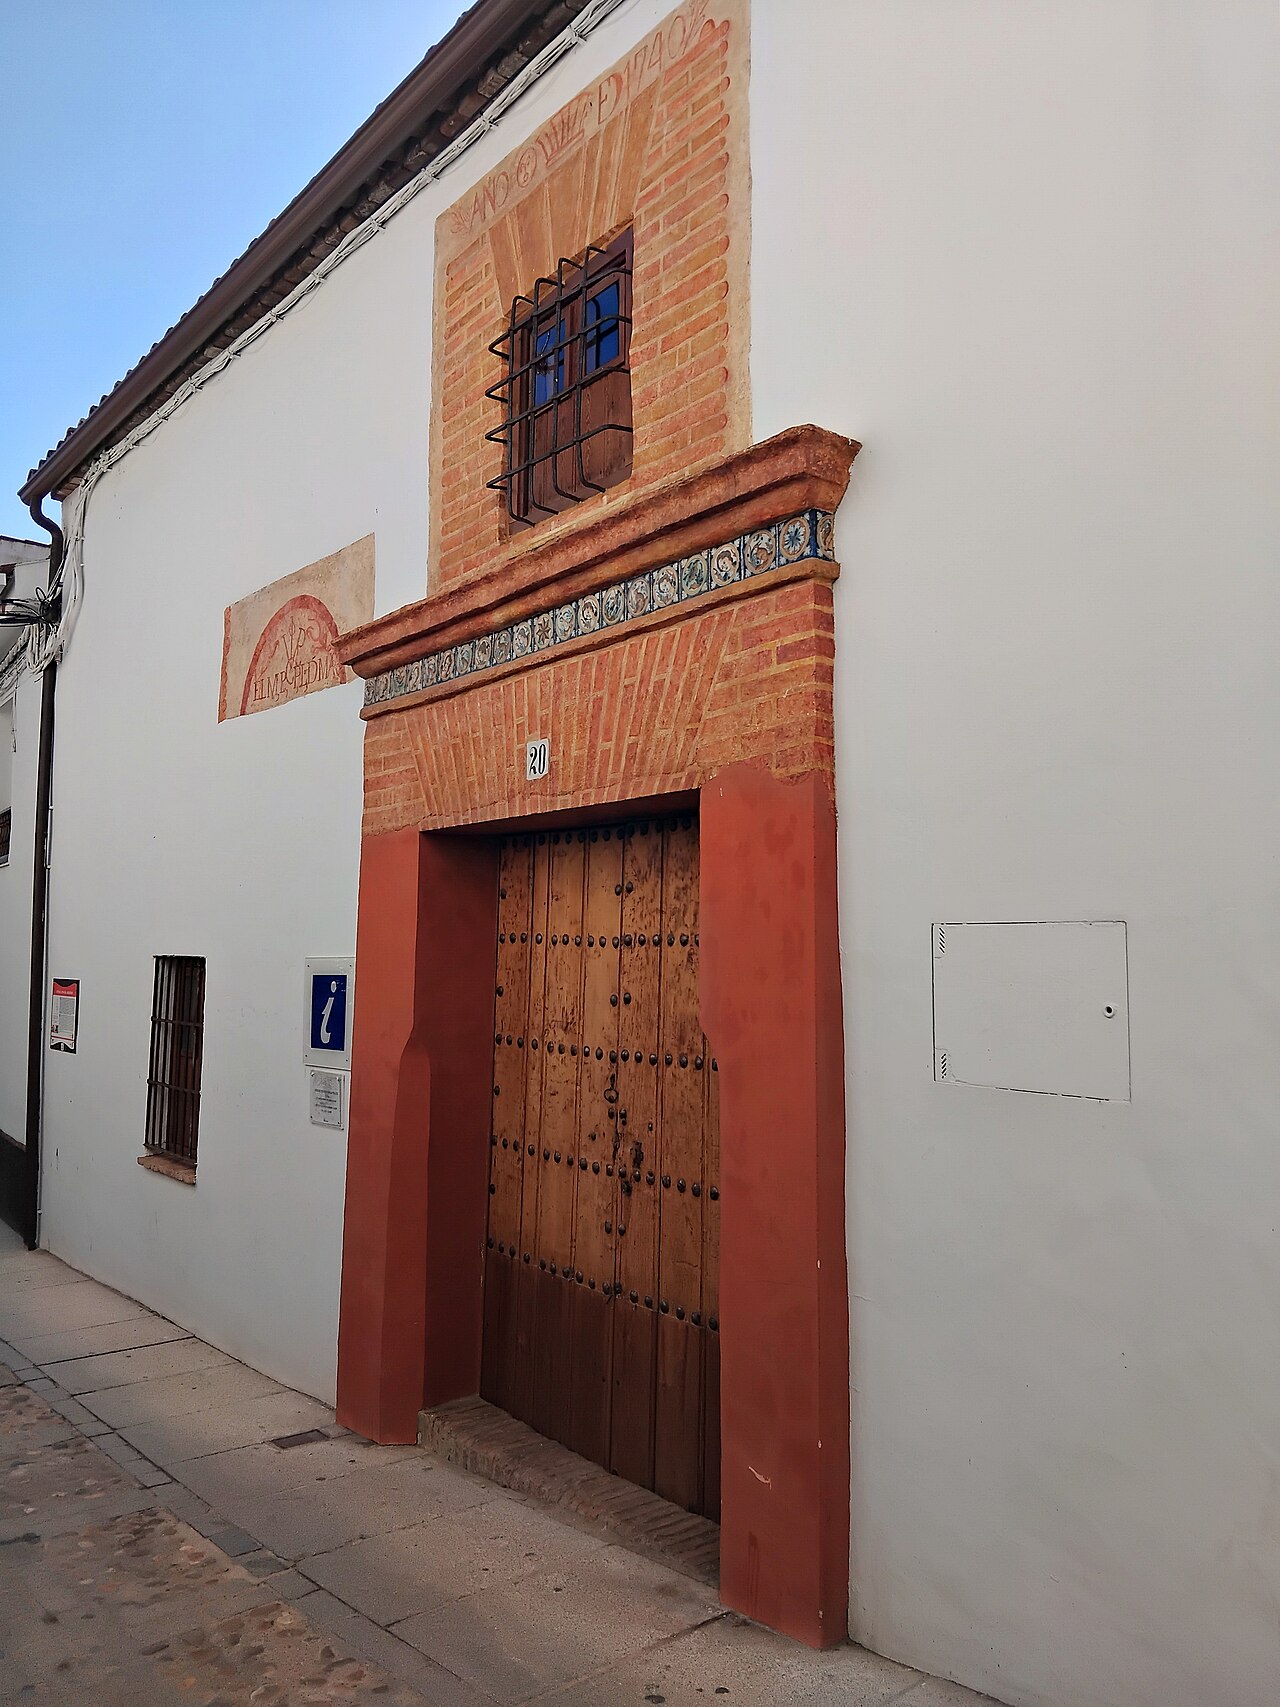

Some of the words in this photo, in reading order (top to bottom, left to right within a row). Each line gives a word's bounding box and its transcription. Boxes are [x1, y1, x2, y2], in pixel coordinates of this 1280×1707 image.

[624, 16, 687, 104] 1740
[529, 743, 546, 775] 20
[320, 980, 337, 1044] i
